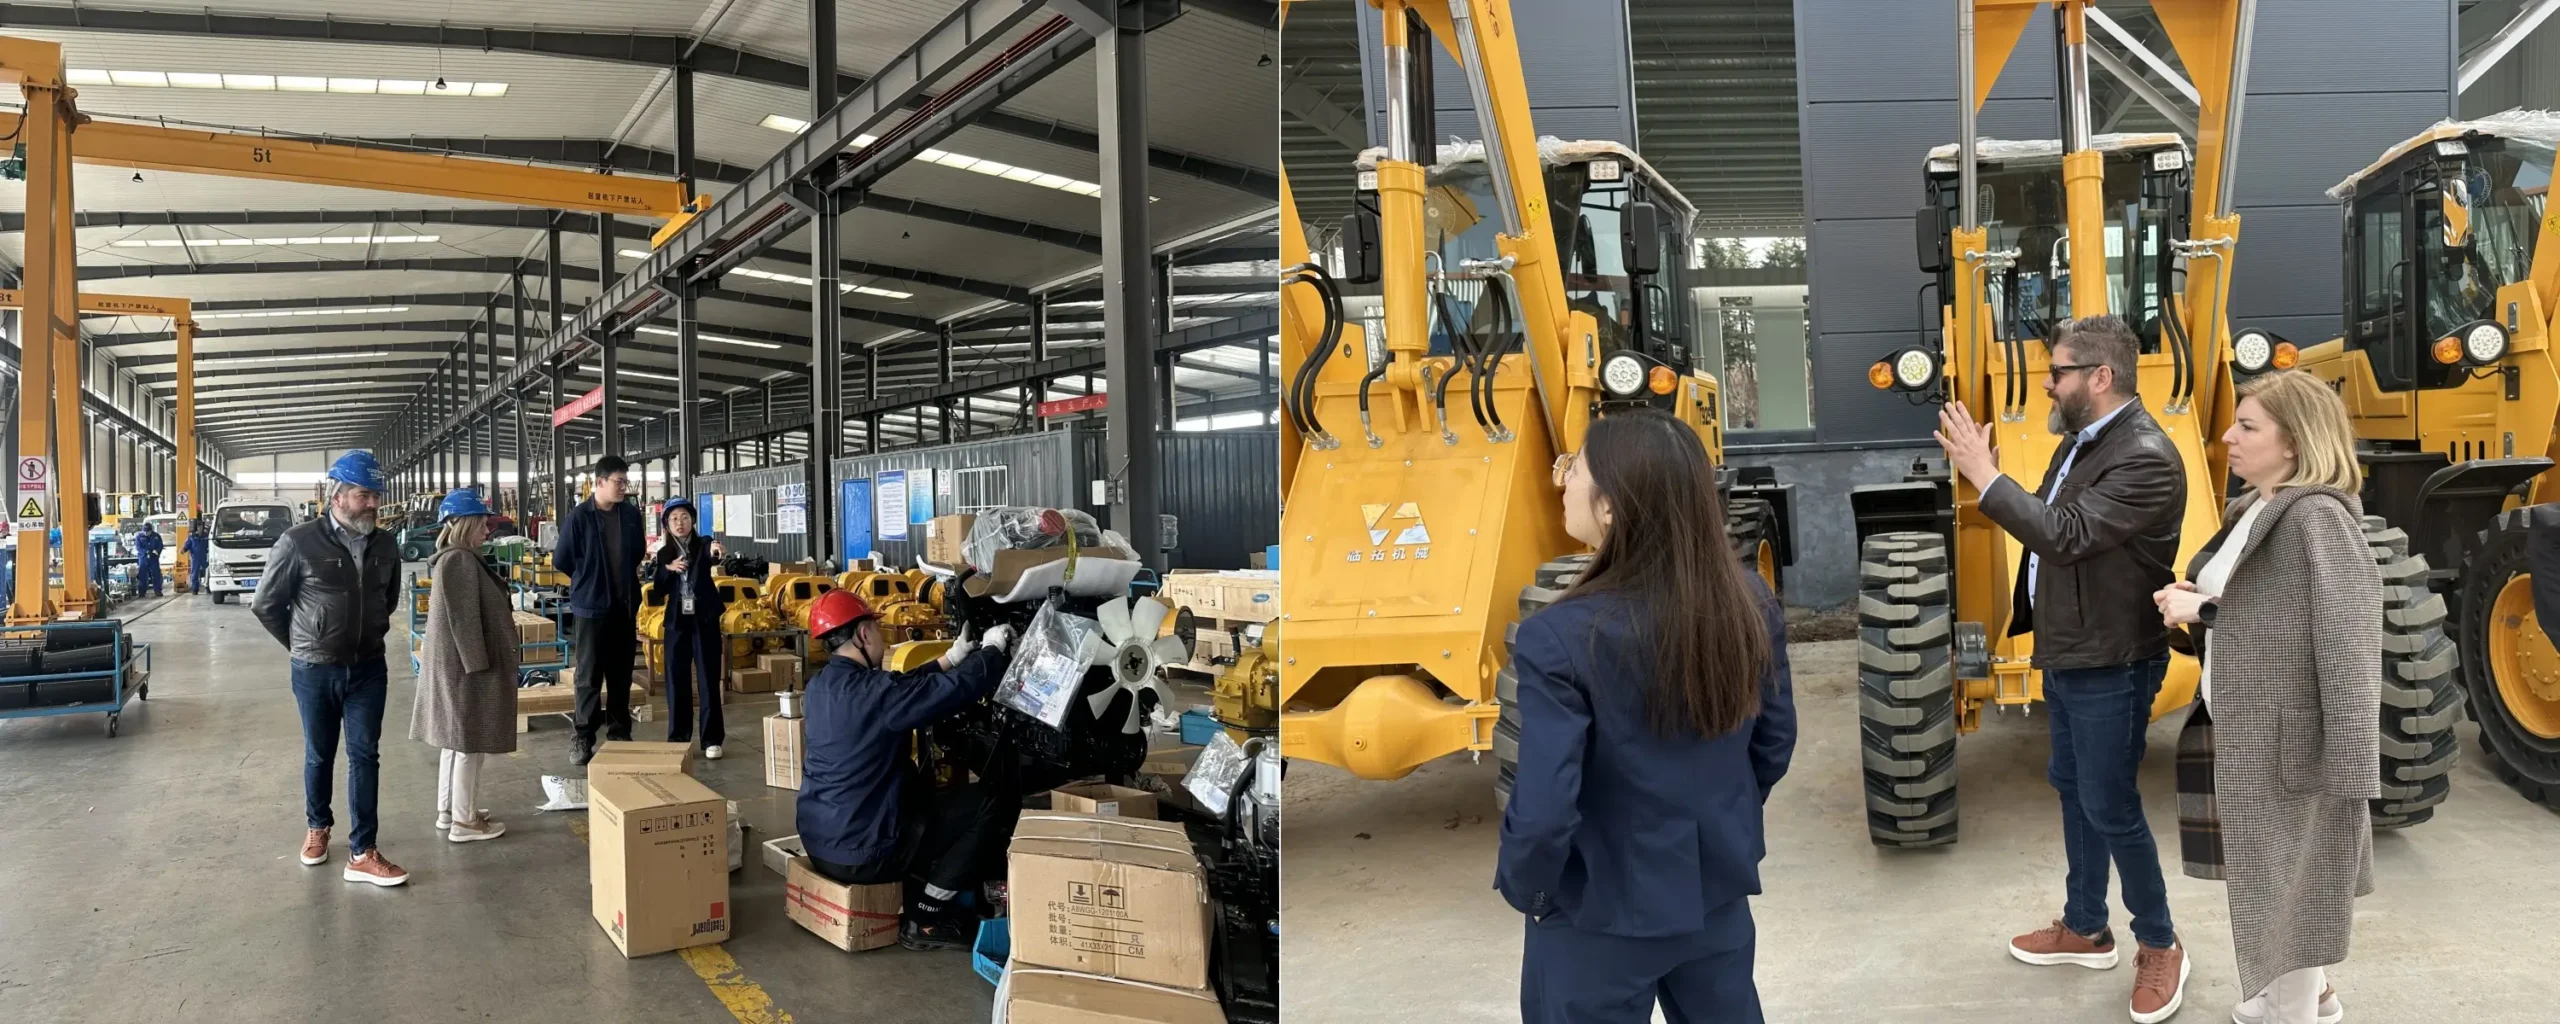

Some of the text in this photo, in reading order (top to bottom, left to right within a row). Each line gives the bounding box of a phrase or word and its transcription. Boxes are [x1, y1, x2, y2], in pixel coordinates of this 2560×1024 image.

[253, 148, 271, 163] 5t
[1130, 934, 1140, 944] 只
[1128, 946, 1144, 955] CM
